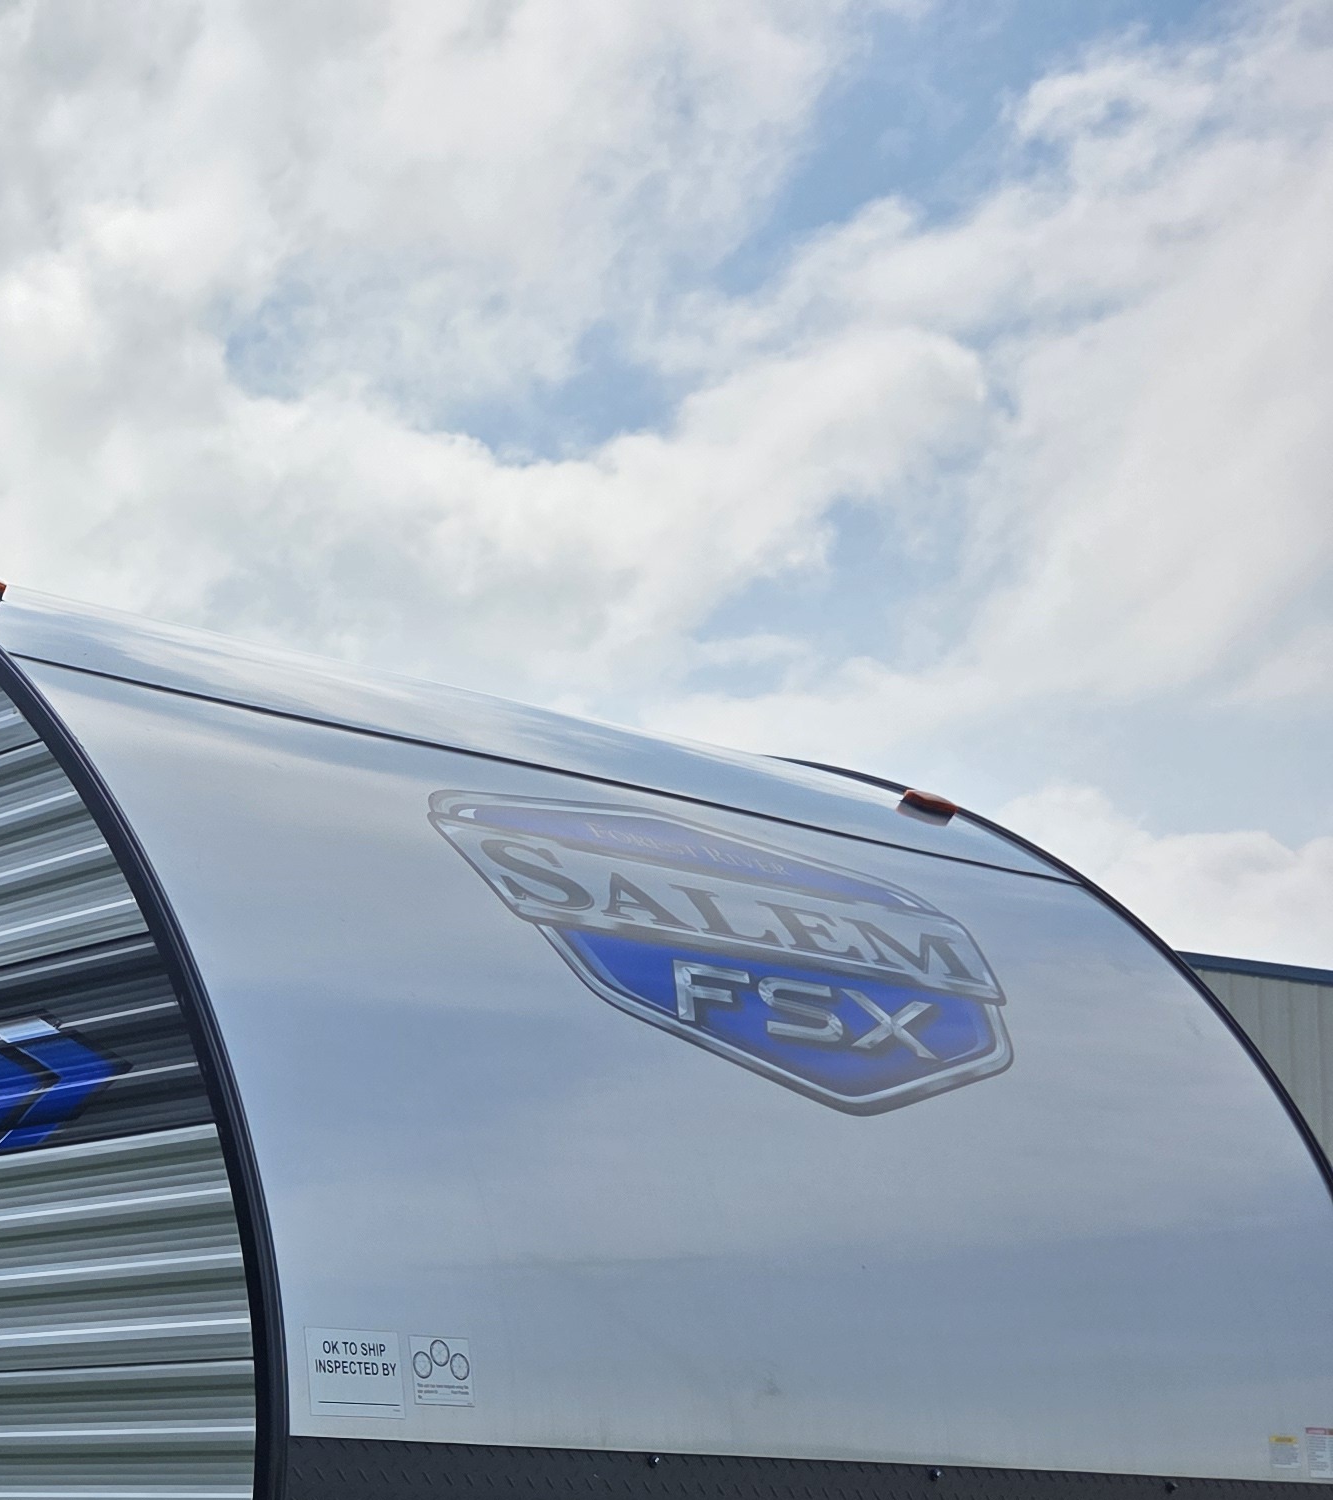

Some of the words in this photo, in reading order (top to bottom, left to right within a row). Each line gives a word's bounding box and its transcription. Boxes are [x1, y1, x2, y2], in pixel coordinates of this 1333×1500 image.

[481, 839, 988, 985] SALEM
[673, 960, 939, 1061] FSX
[315, 1358, 379, 1376] INSPECTED
[381, 1362, 397, 1377] BY
[322, 1340, 340, 1355] OK
[342, 1341, 358, 1356] TO
[360, 1342, 386, 1357] SHIP
